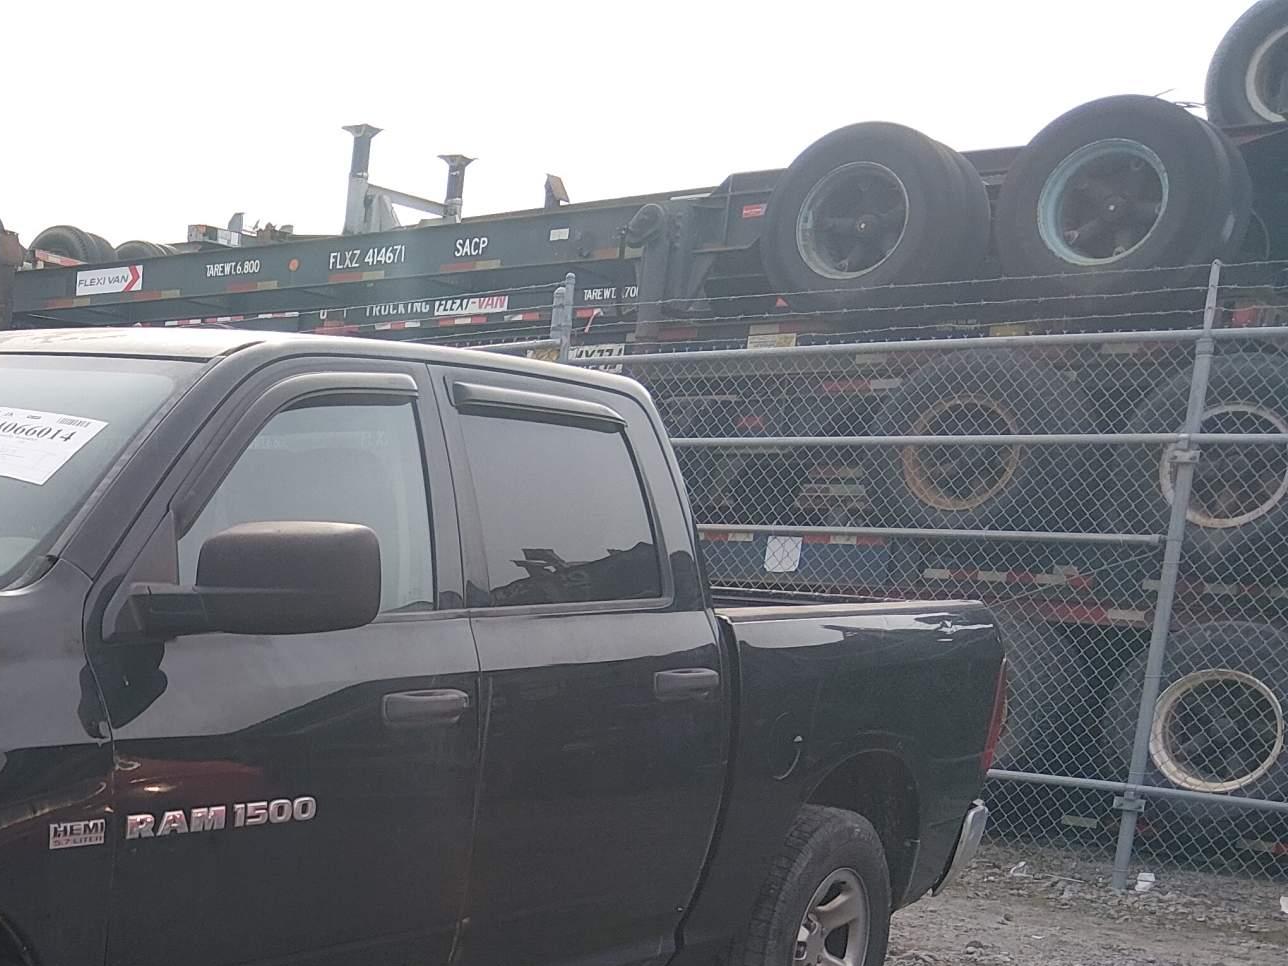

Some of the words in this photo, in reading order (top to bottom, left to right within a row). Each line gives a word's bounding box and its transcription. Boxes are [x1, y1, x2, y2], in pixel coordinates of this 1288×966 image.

[455, 237, 488, 257] SACP
[329, 250, 360, 270] FLXZ
[364, 245, 406, 266] 414671
[78, 276, 105, 288] FLEXI
[108, 275, 129, 286] VAN
[125, 805, 226, 840] RAM
[233, 796, 317, 828] 1500
[53, 820, 105, 838] HEMI
